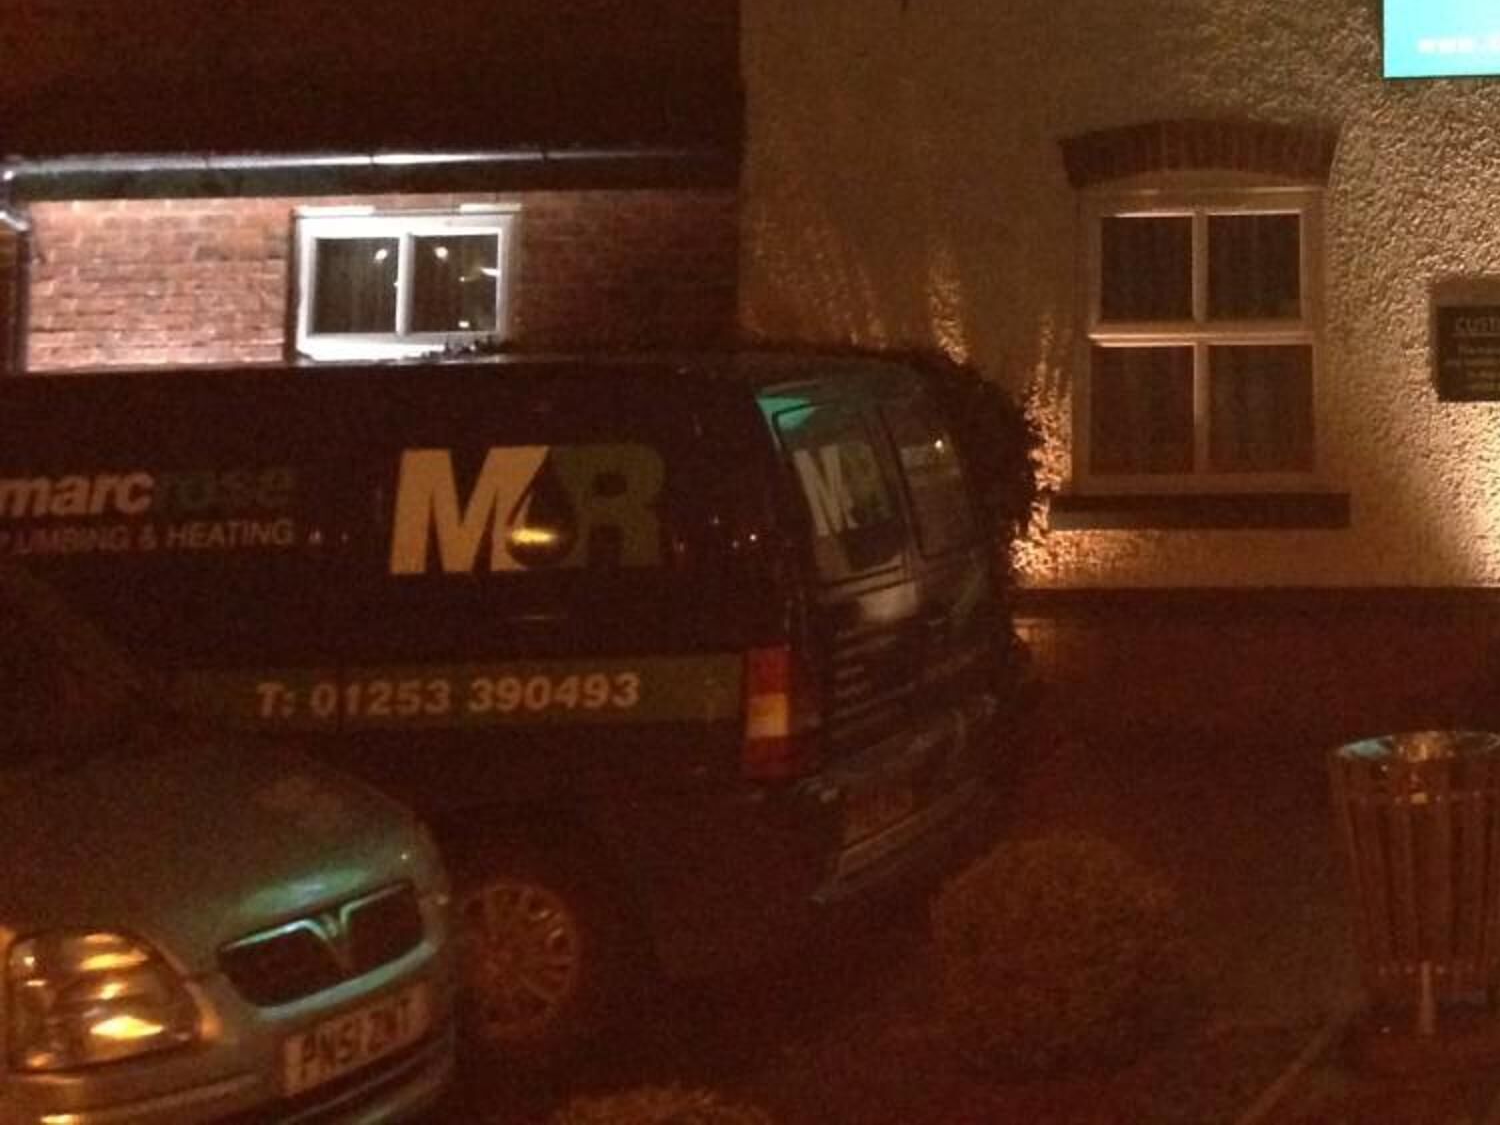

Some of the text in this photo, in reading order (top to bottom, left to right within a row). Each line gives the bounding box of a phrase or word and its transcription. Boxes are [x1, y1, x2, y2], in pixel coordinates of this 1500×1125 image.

[166, 518, 294, 549] HEATING
[255, 672, 641, 718] T: 01253 390493
